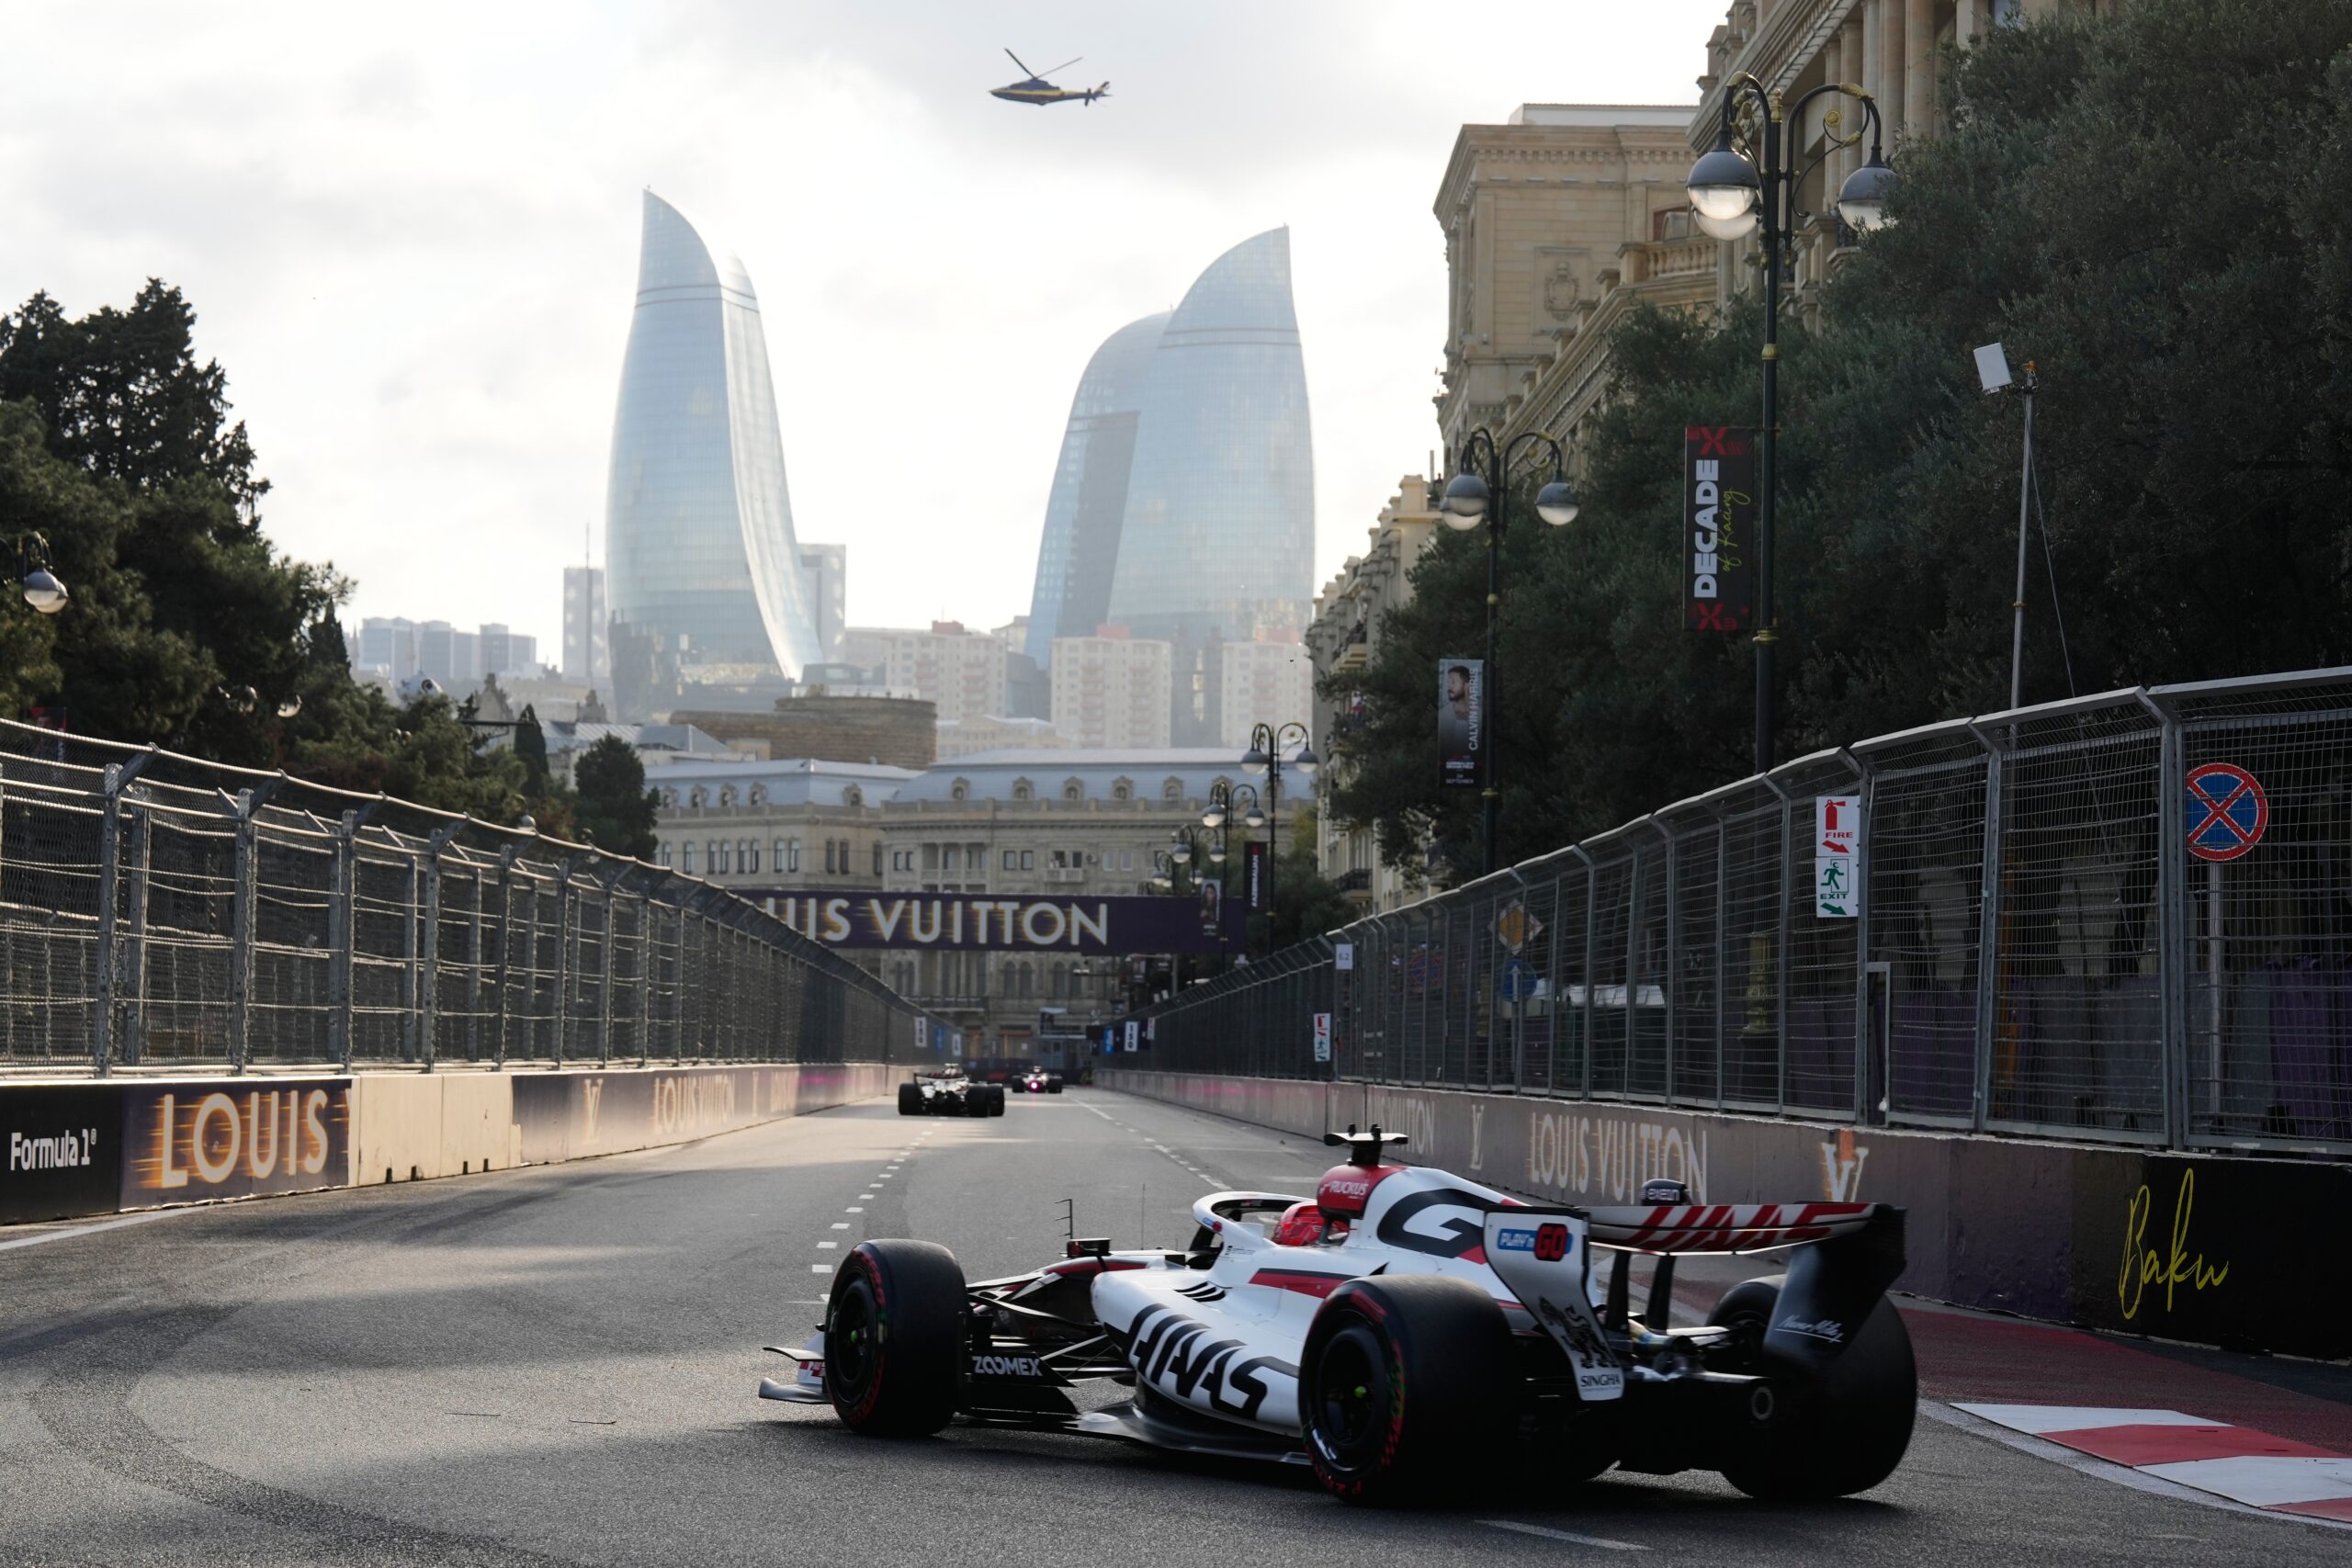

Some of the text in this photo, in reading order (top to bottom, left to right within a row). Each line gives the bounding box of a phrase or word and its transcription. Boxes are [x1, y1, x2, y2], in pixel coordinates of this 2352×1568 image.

[1694, 459, 1719, 598] DECADE
[1713, 487, 1751, 571] of Racing
[1468, 668, 1478, 750] CALVIN HARRIS
[870, 899, 1108, 946] VUITTON
[653, 1076, 695, 1135] LOUIS
[10, 1129, 78, 1171] Formula
[161, 1089, 328, 1189] LOUIS
[1531, 1111, 1707, 1205] LOUIS VUITTON
[1329, 1180, 1369, 1196] RUCKUS
[1535, 1224, 1567, 1259] GO
[2119, 1168, 2229, 1320] Baku
[971, 1355, 1044, 1377] ZOOMEX
[1579, 1373, 1621, 1388] SINGHA
